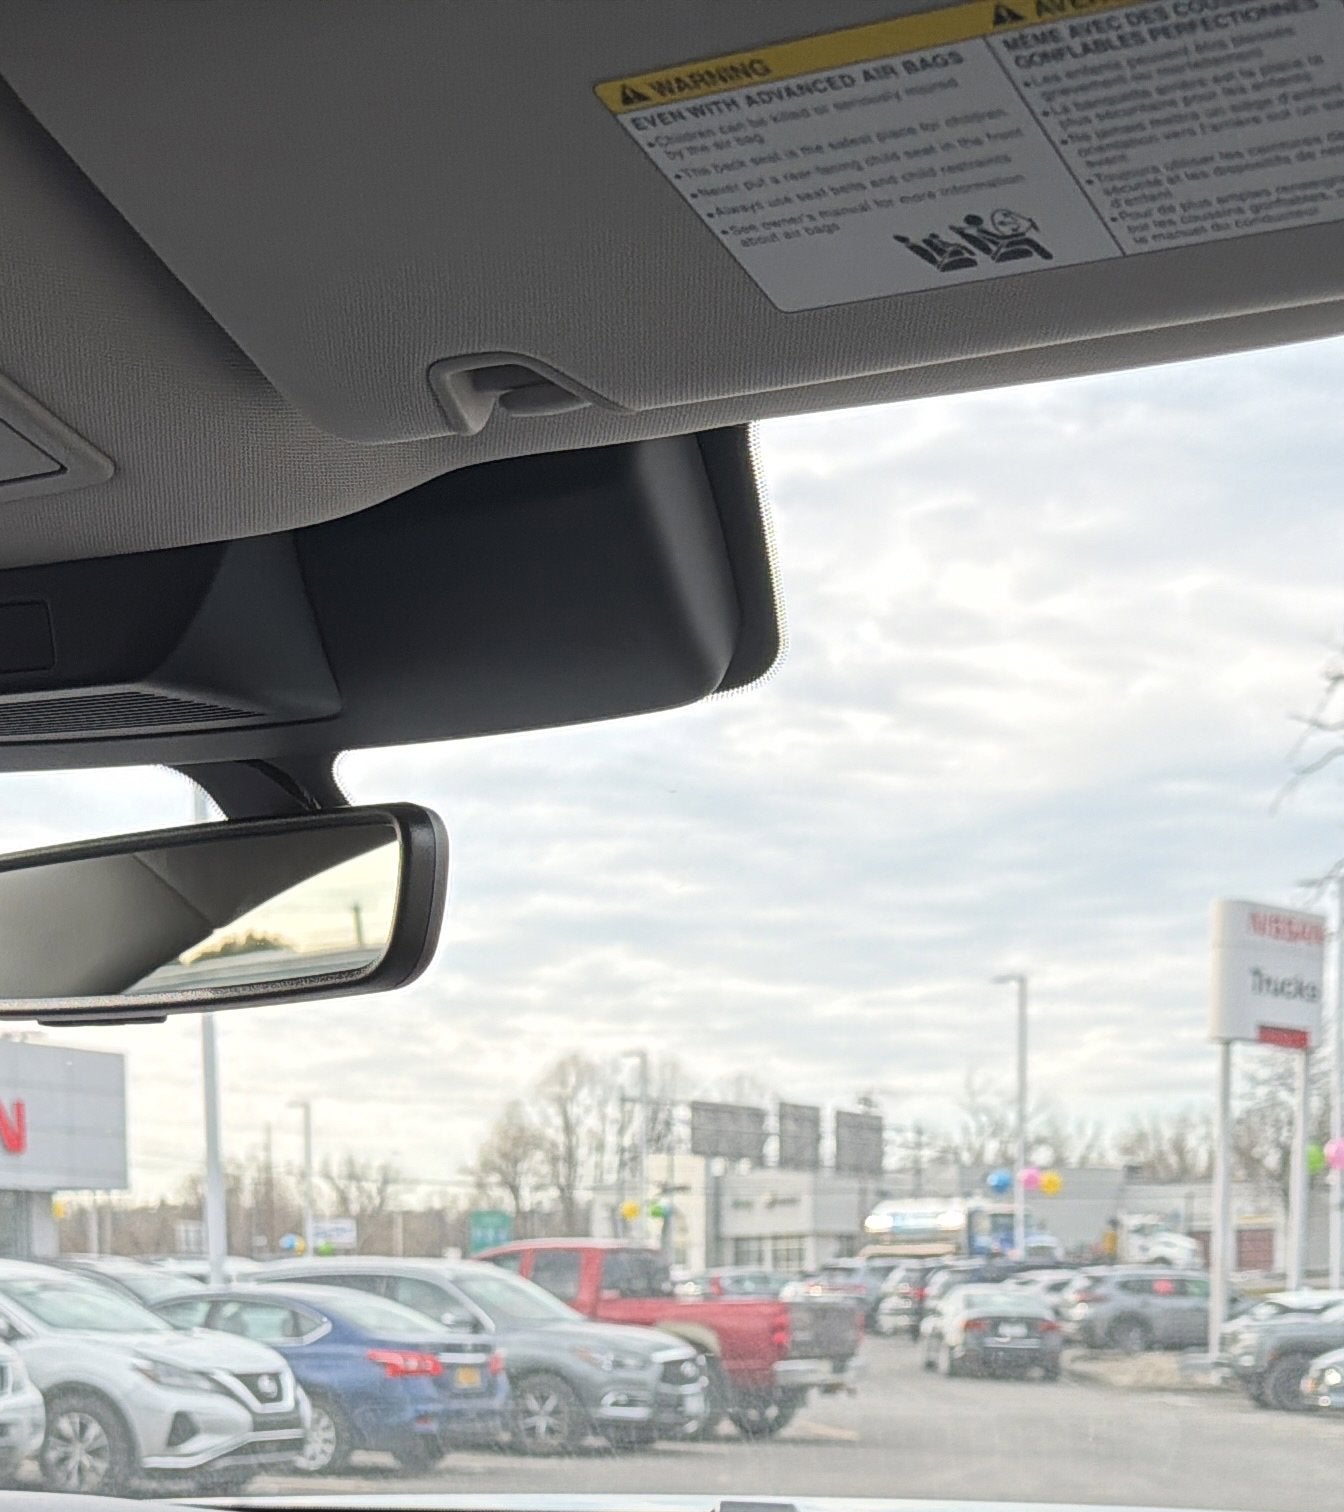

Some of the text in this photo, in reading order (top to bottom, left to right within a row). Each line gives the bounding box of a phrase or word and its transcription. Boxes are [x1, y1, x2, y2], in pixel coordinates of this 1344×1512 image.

[630, 51, 964, 131] EVEN WITH ADVANCED AIR BAGS
[649, 58, 772, 98] WARNING
[1249, 966, 1319, 1003] Trucks
